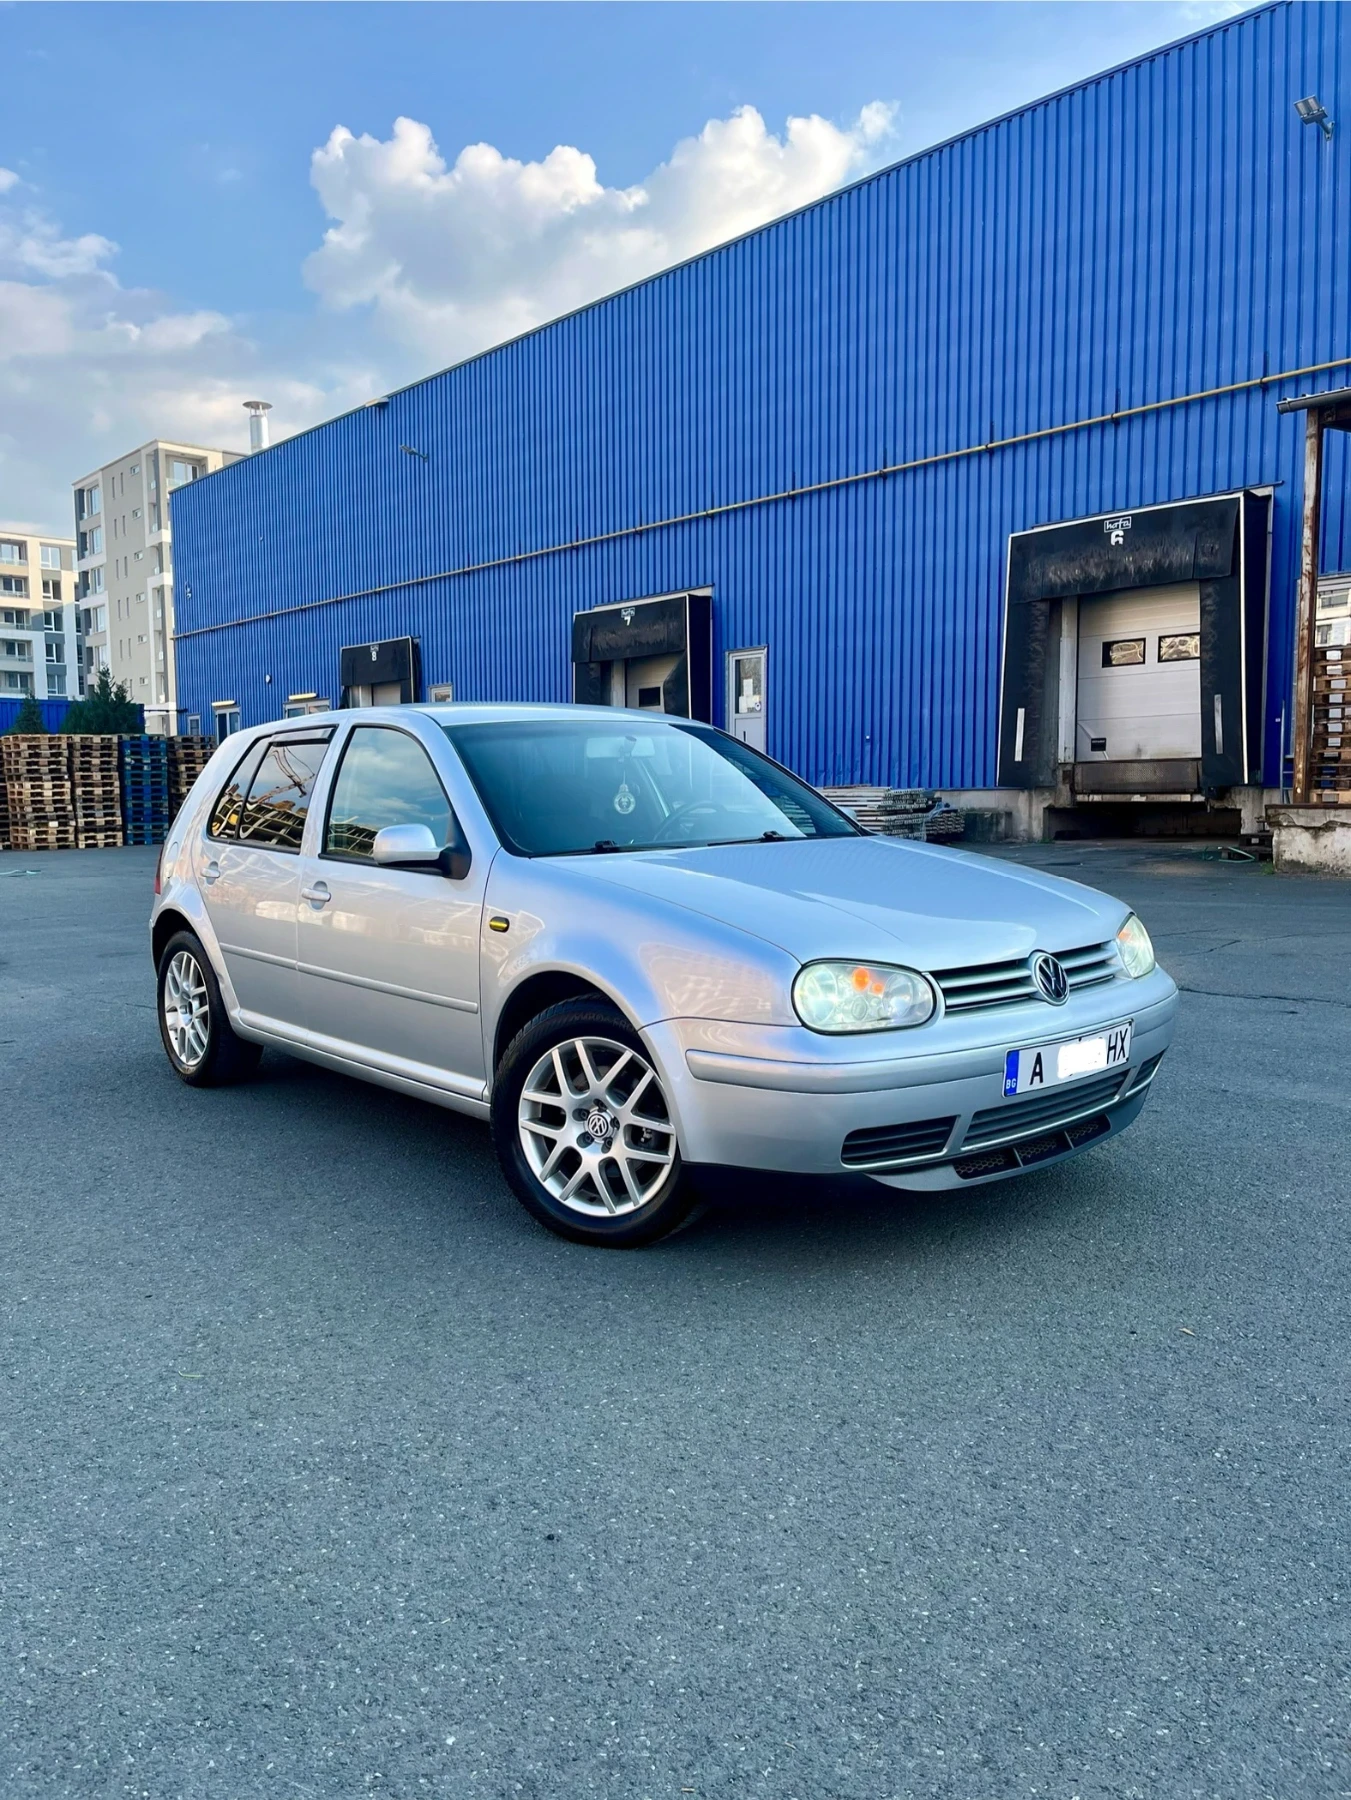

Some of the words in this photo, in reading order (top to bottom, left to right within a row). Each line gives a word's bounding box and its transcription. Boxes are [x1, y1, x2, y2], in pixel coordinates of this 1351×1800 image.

[1111, 530, 1124, 546] 6
[624, 615, 631, 626] 7
[371, 651, 377, 662] 8
[1029, 1052, 1043, 1086] A
[1106, 1028, 1128, 1065] HX
[1005, 1078, 1017, 1089] BG
